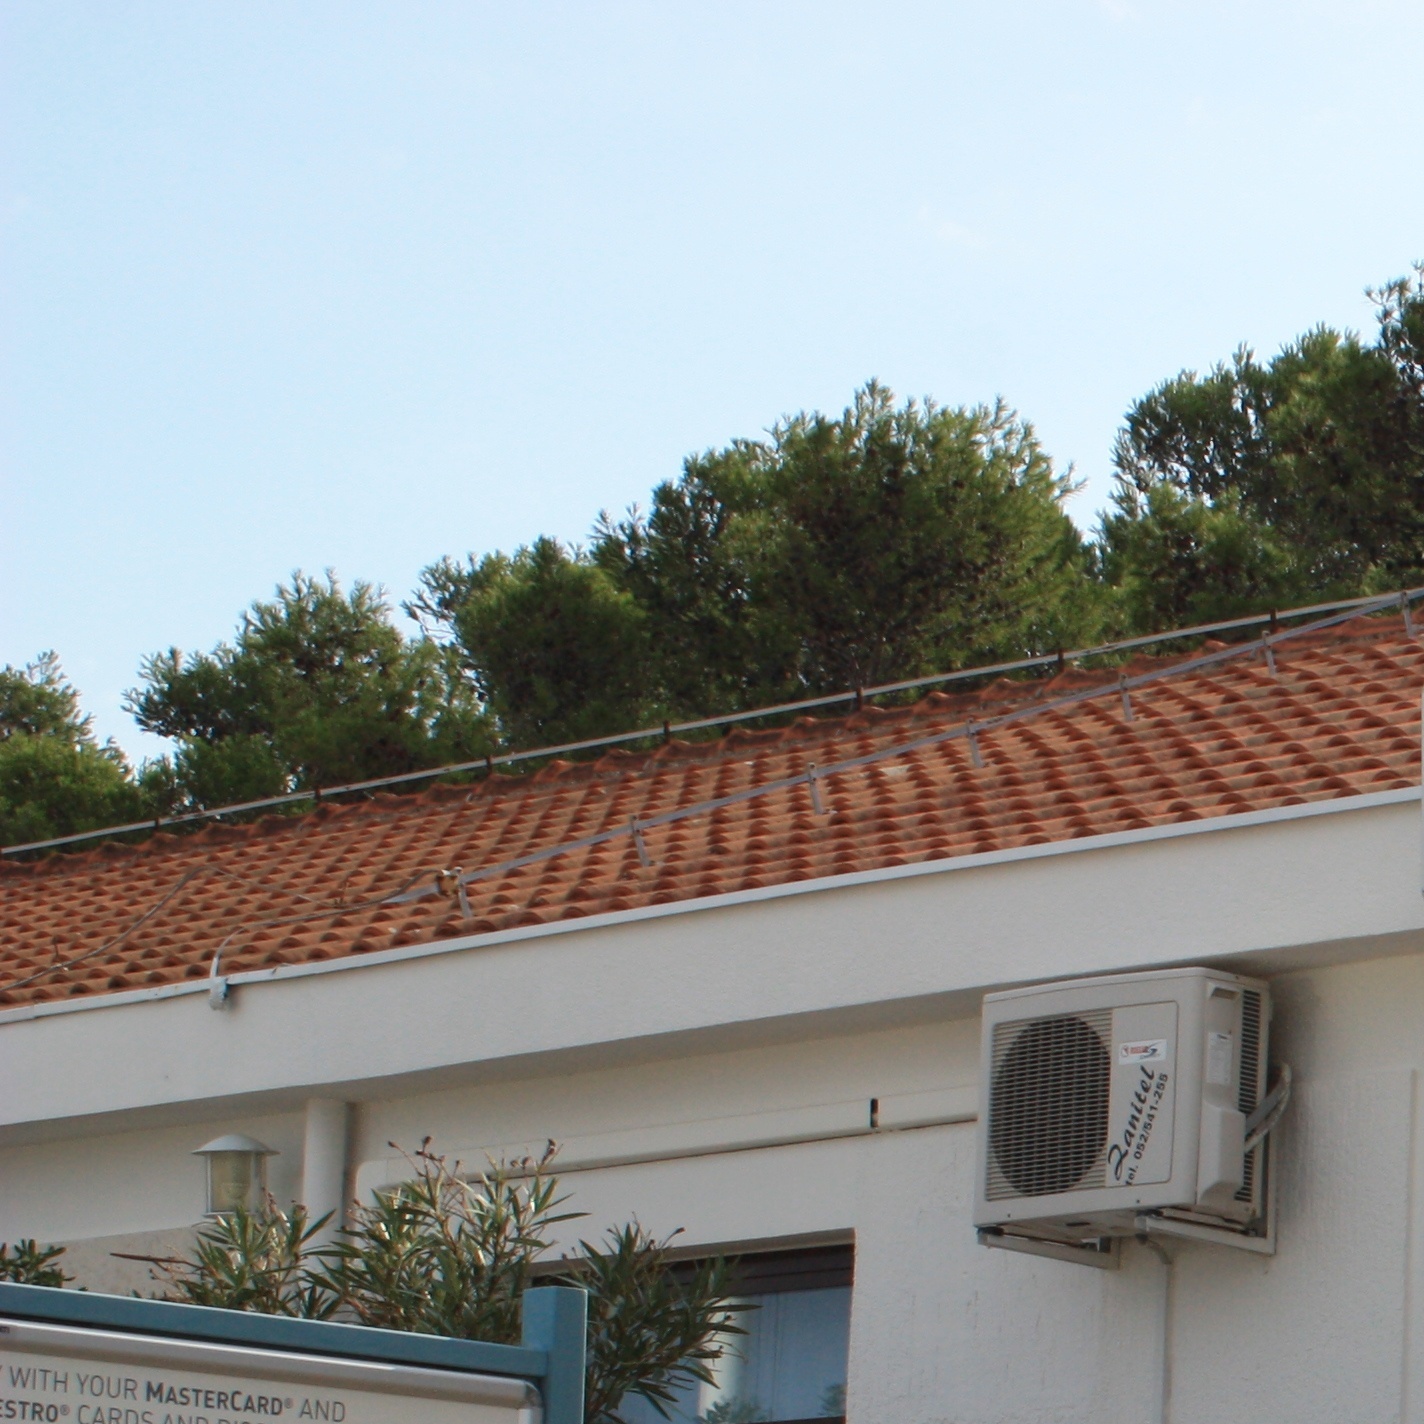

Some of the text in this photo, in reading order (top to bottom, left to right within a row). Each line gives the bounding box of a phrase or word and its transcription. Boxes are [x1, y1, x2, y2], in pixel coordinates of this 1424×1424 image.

[9, 1365, 69, 1393] WITH
[76, 1373, 138, 1401] YOUR
[300, 1399, 346, 1423] AND
